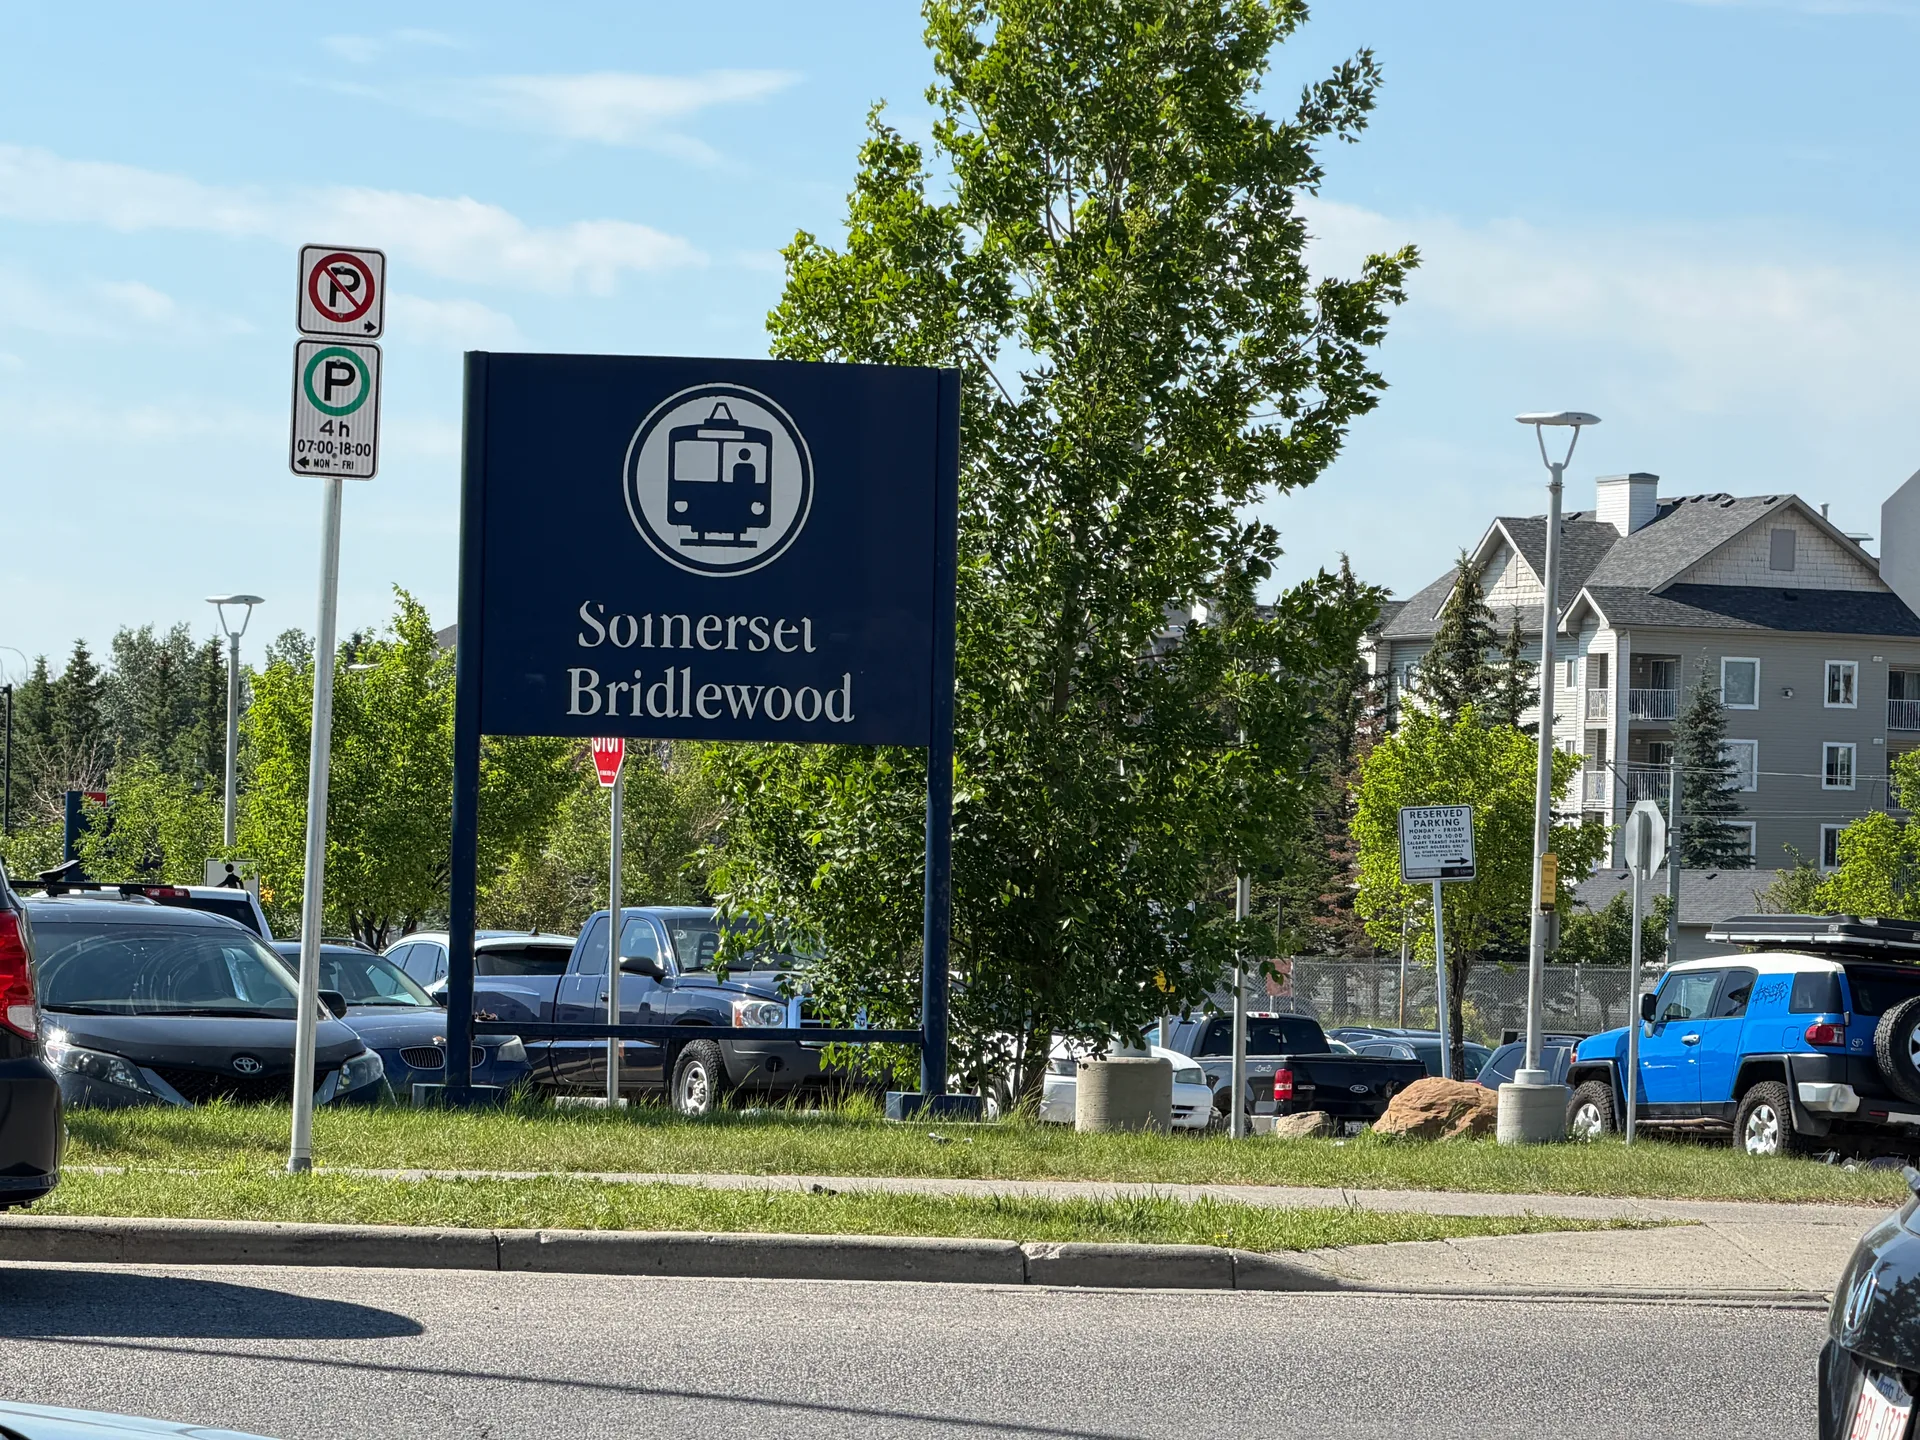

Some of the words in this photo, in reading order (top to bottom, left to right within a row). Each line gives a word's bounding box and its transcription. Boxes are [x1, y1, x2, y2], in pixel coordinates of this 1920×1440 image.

[324, 361, 356, 401] P
[313, 458, 330, 468] MON
[342, 460, 354, 470] FRI
[566, 665, 855, 723] Bridlewood
[1409, 809, 1463, 819] RESERVED
[1413, 818, 1460, 828] PARKING
